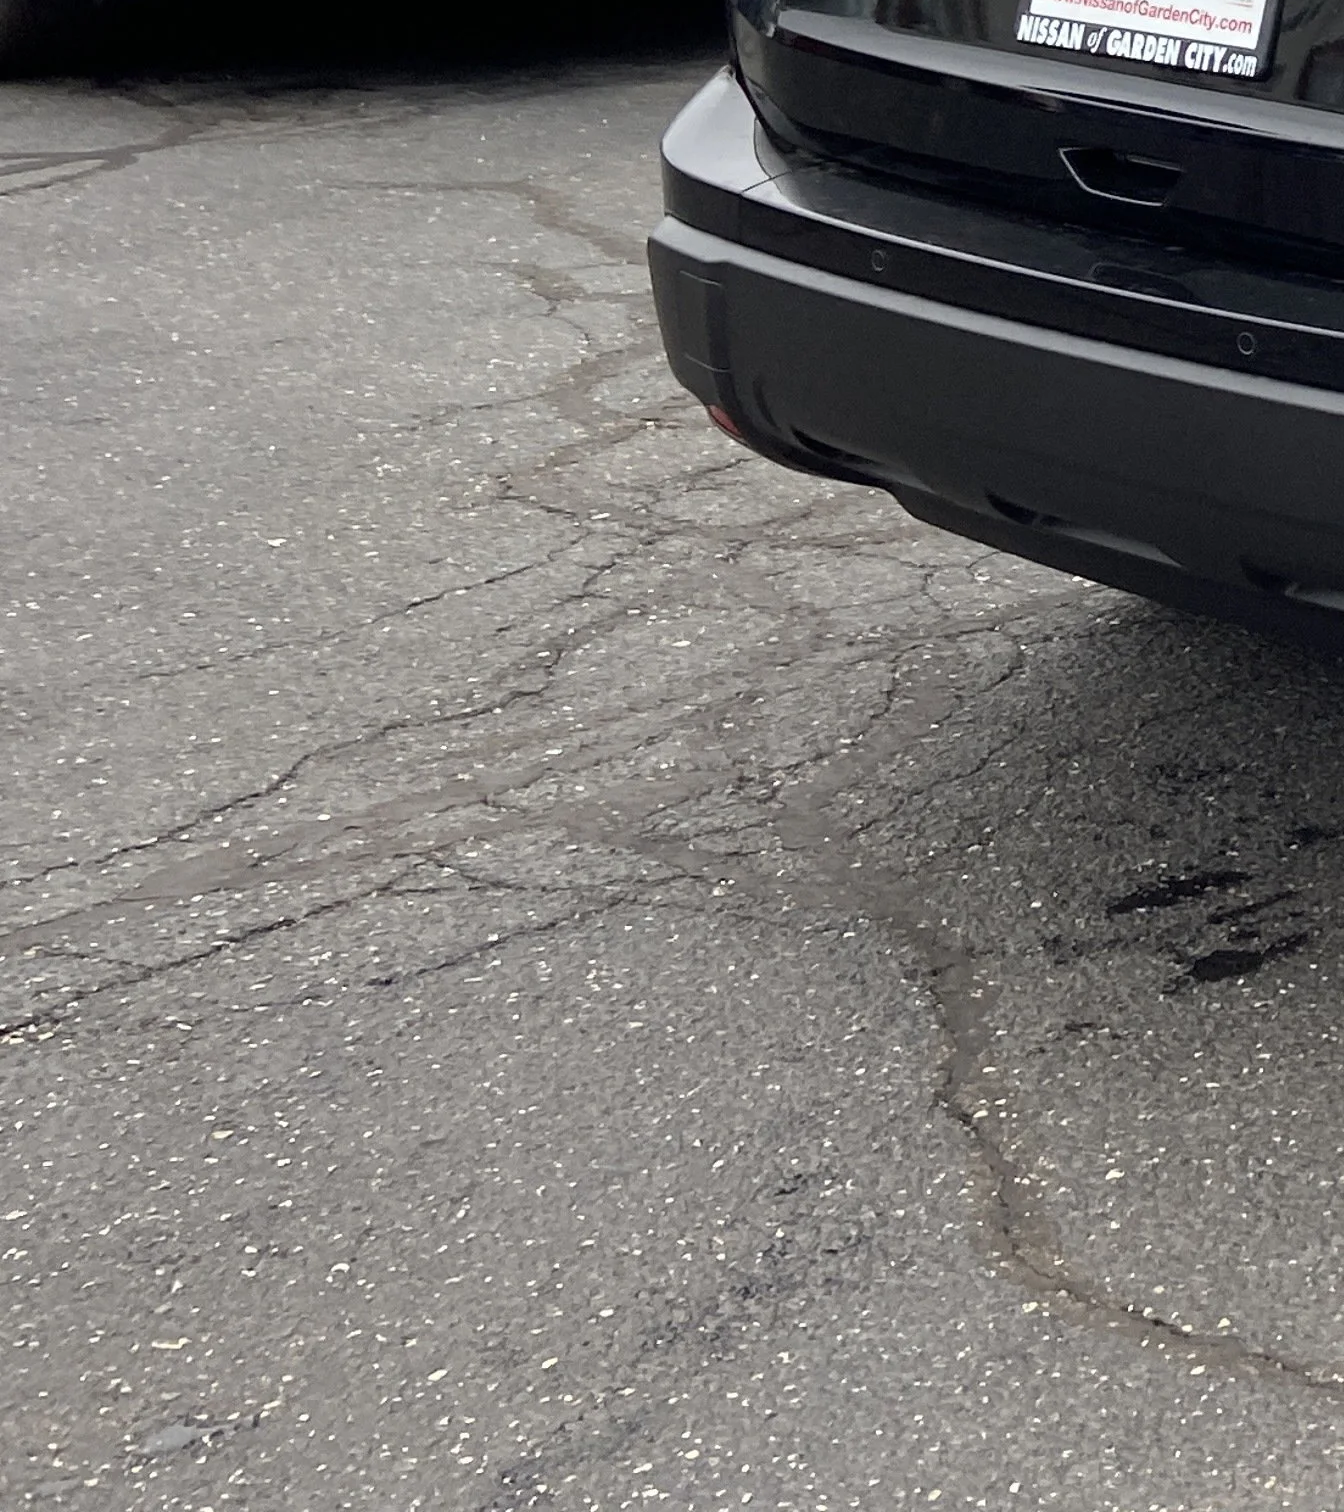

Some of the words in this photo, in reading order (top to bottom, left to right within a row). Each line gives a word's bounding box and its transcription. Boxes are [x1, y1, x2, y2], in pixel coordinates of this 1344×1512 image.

[1016, 14, 1086, 50] NISSAN
[1087, 27, 1107, 54] of
[1106, 29, 1182, 67] GARDEN
